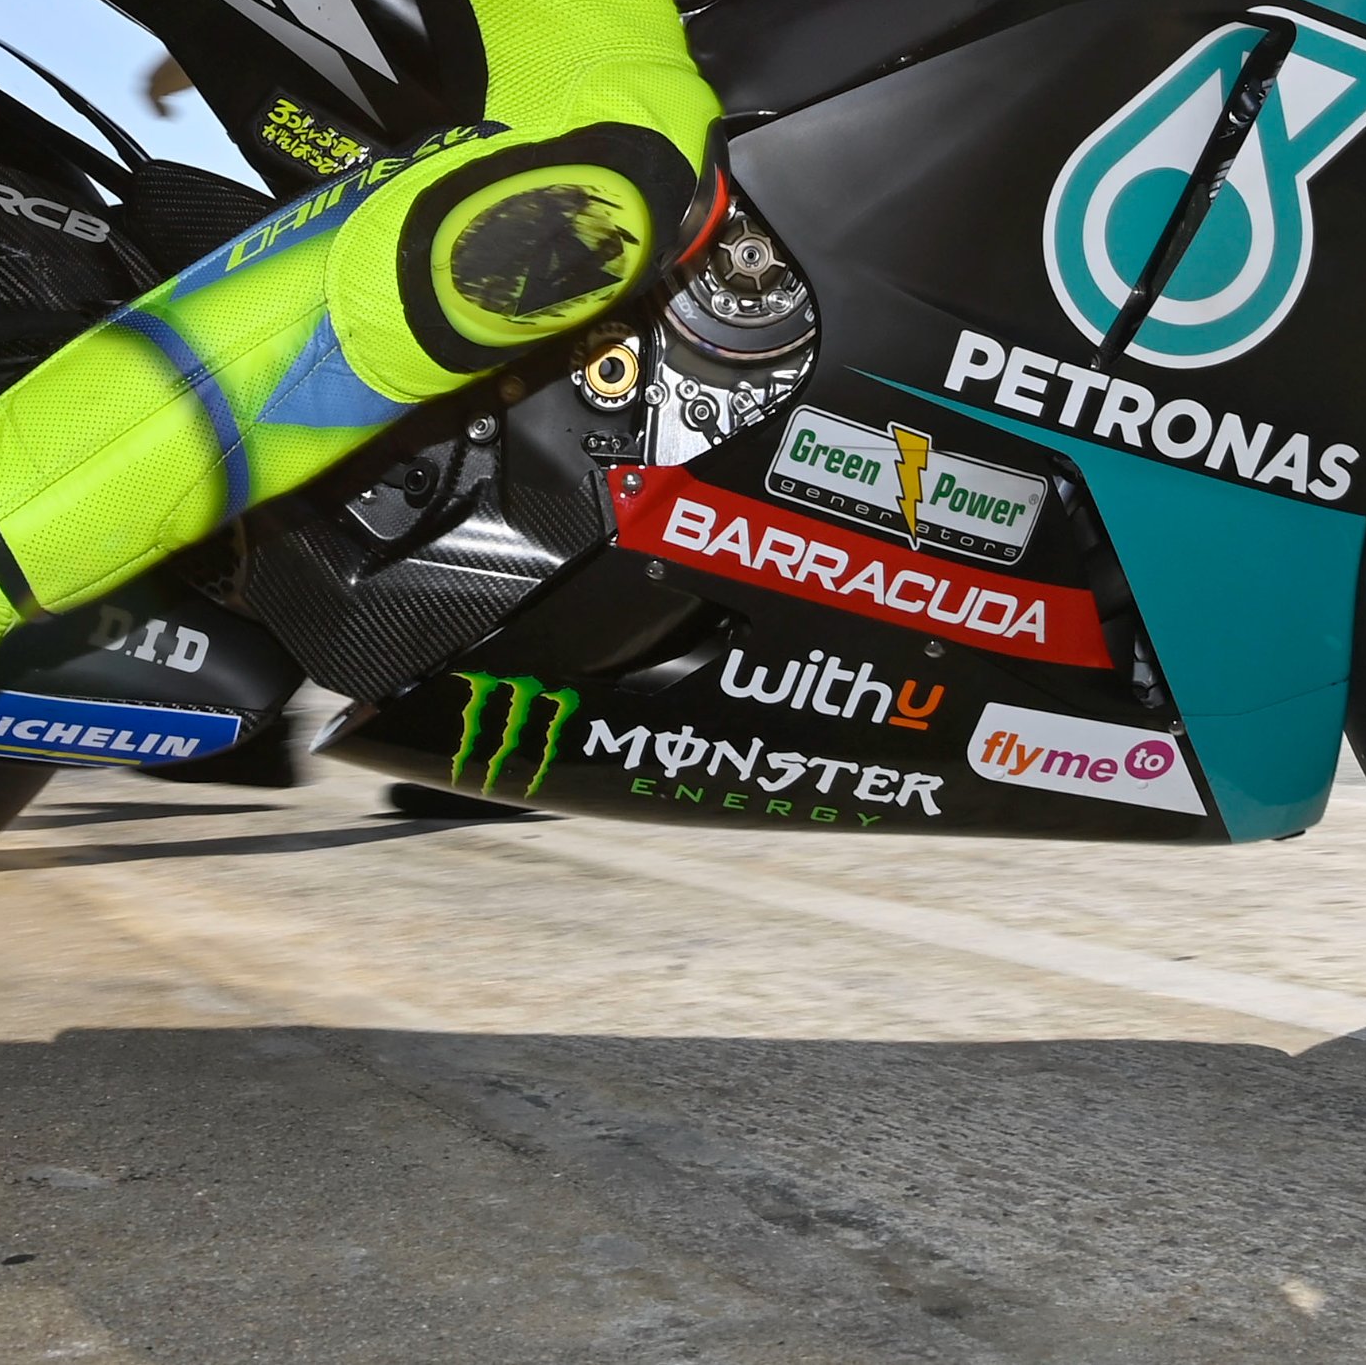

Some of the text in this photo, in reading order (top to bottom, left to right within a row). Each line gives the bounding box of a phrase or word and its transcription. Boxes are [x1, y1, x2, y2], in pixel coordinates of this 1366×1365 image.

[789, 427, 1026, 527] Green Power
[944, 329, 1361, 502] PETRONAS
[663, 496, 1047, 644] BARRACUDA
[630, 777, 882, 827] ENERGY
